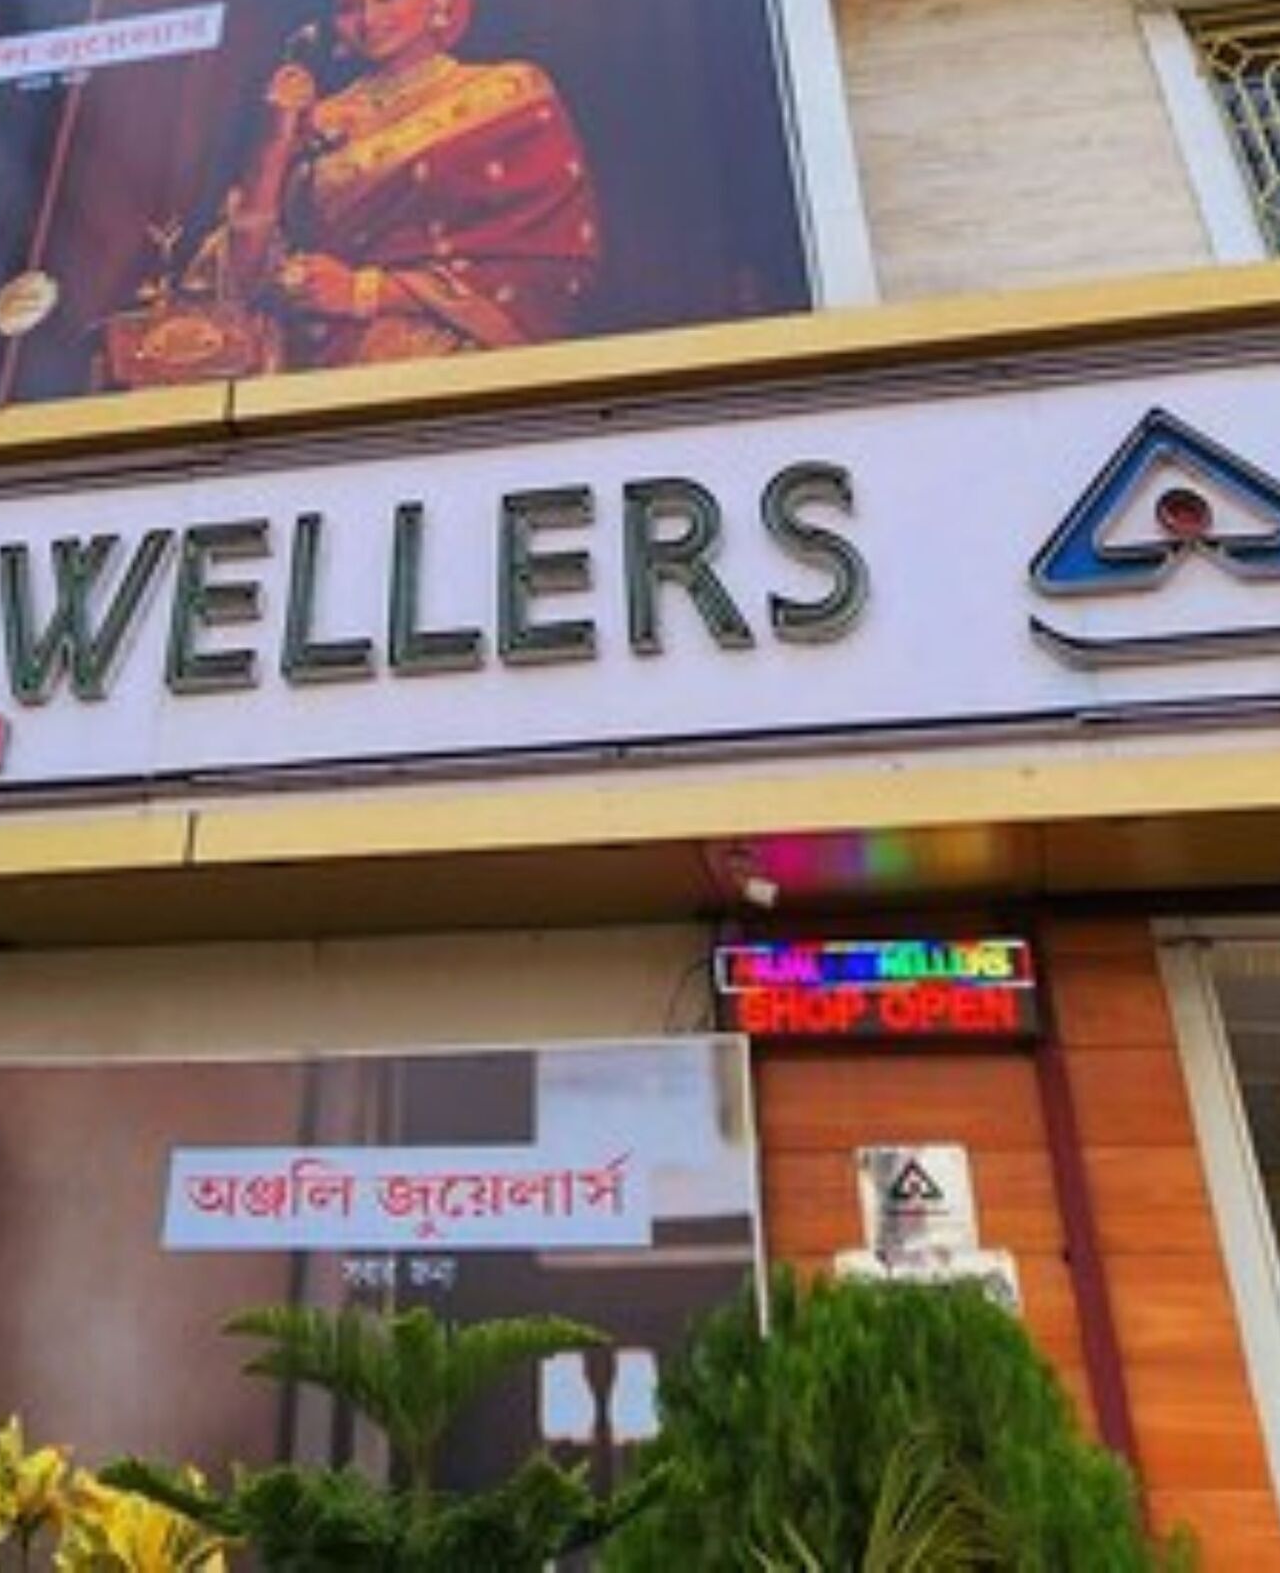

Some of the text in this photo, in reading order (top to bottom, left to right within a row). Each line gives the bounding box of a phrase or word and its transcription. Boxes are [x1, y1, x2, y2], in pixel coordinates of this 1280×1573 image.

[738, 984, 1018, 1033] SHOP OPEN
[183, 1148, 636, 1239] অঞ্জলি জুয়েলার্স
